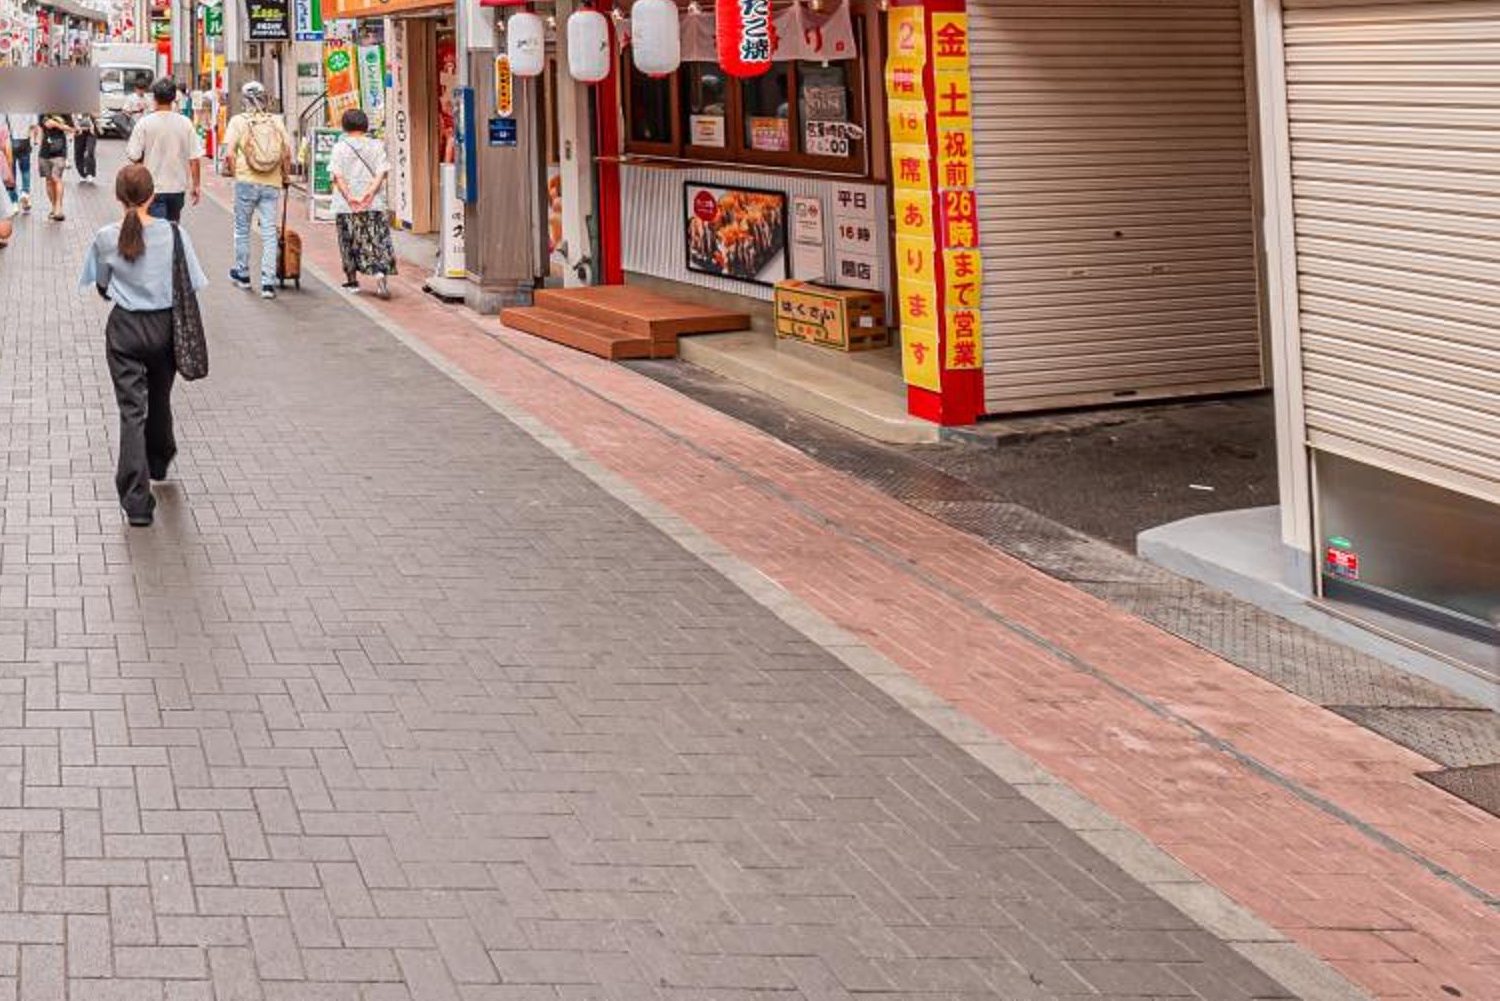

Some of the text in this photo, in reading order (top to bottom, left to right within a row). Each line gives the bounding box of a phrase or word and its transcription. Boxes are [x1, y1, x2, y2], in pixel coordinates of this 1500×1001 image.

[837, 190, 867, 209] 平日
[936, 22, 977, 368] 金土祝前26時まで営業
